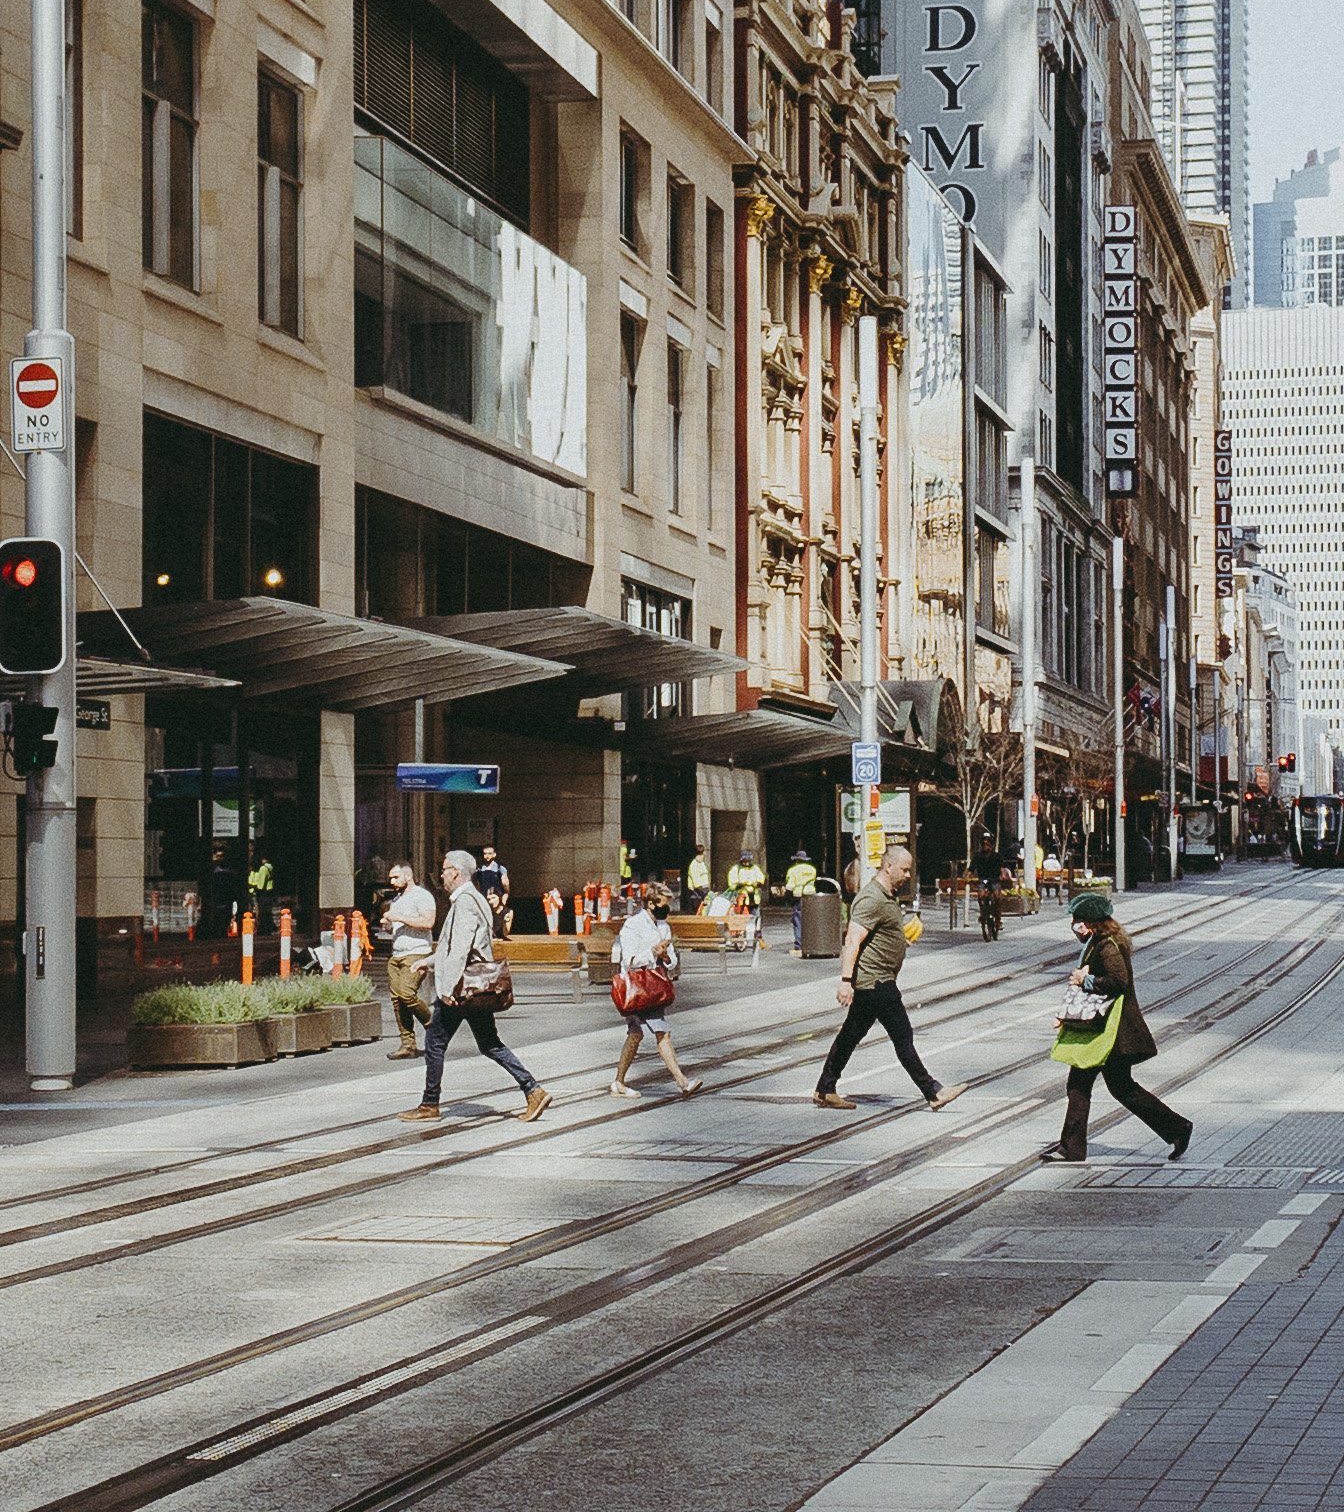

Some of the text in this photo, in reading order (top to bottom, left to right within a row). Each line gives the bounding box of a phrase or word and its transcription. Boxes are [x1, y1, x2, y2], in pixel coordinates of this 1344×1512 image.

[1107, 211, 1133, 456] DYMOCKS
[27, 414, 50, 428] NO
[17, 431, 59, 444] ENTRY
[1216, 433, 1233, 597] GOWINGS
[478, 769, 492, 785] T
[859, 766, 875, 779] 20
